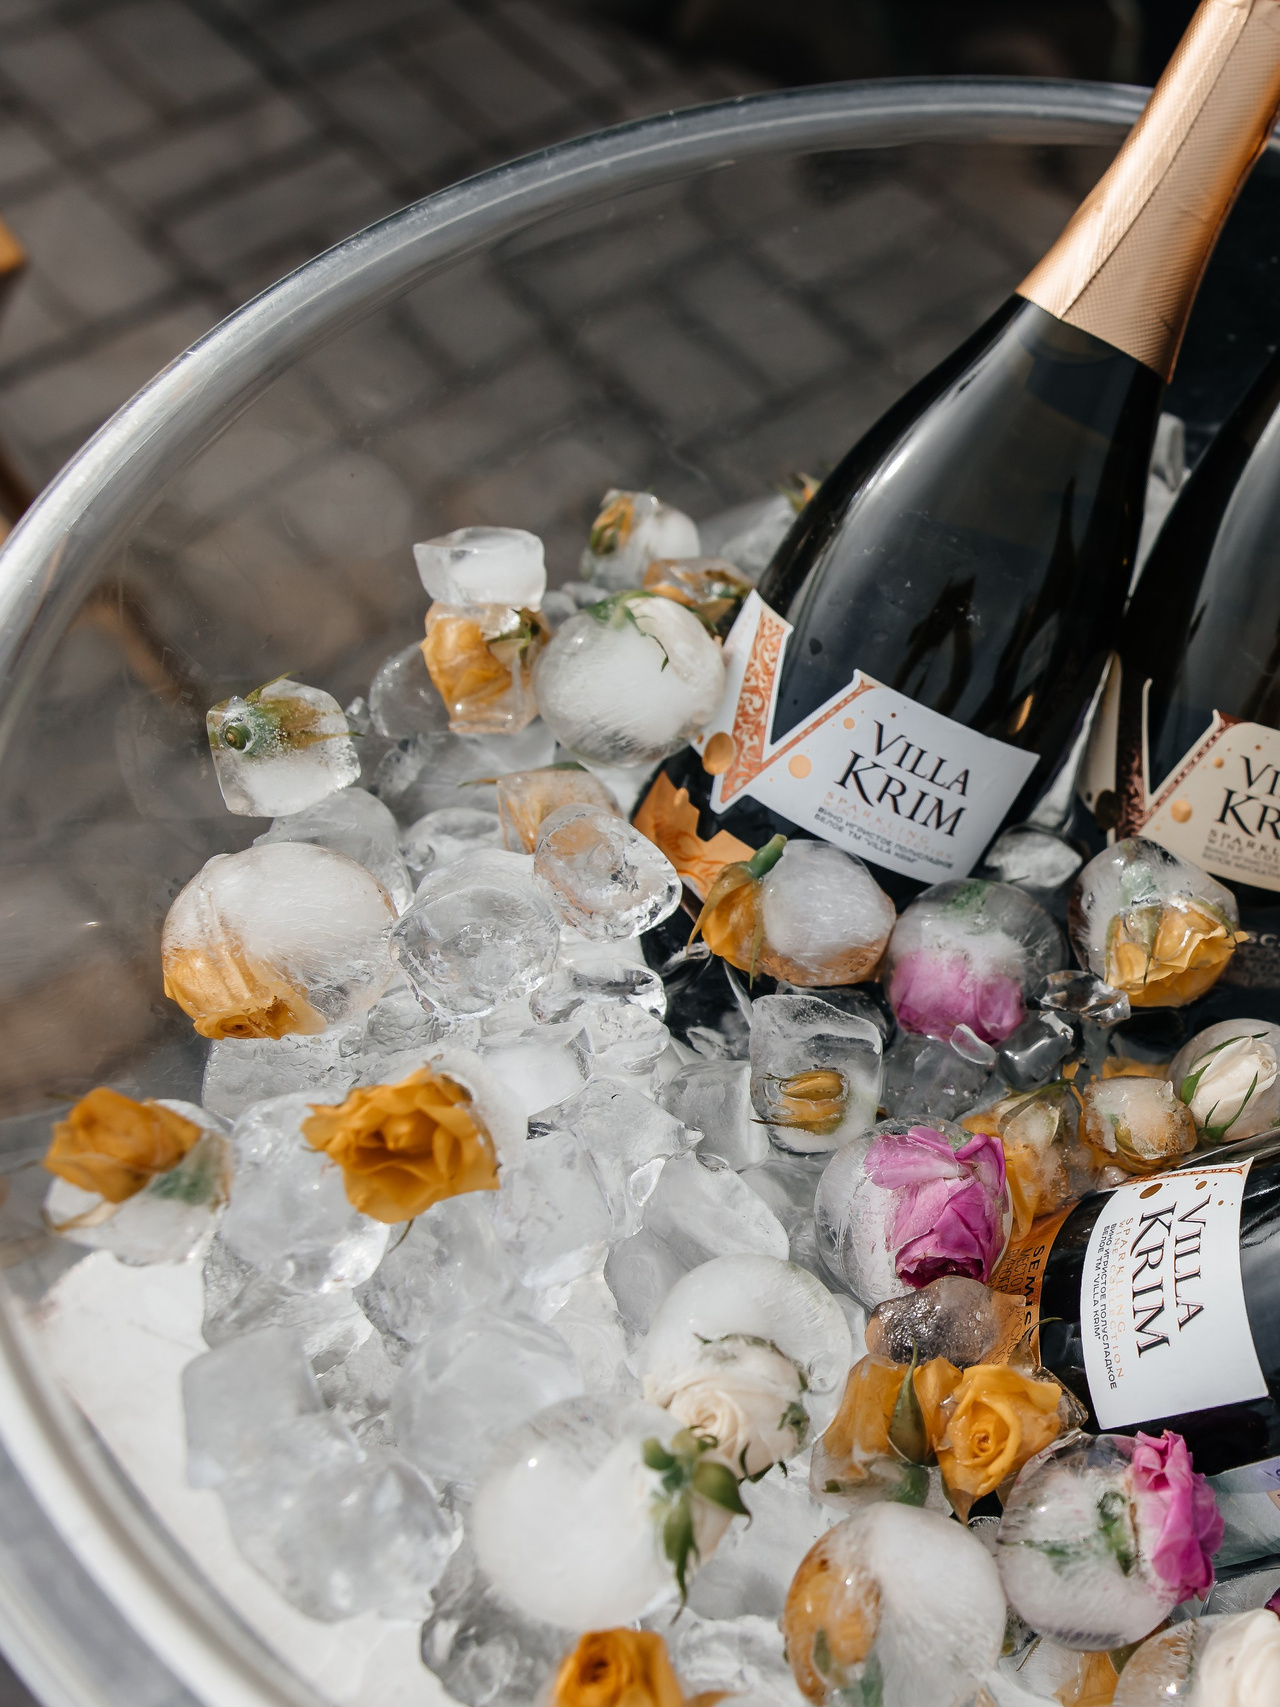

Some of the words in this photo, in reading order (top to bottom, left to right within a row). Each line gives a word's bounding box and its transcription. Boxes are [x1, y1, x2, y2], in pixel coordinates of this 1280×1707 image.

[833, 749, 967, 837] KRIM
[873, 719, 970, 797] VILLA
[1095, 1256, 1103, 1271] ТМ
[1098, 1225, 1110, 1253] БЕЛОЕ
[1100, 1248, 1110, 1300] ИГРИСТОЕ
[1106, 1223, 1117, 1246] ВИНО
[1112, 1219, 1125, 1255] WINE
[1116, 1217, 1134, 1333] SPARKLING
[1173, 1193, 1212, 1332] VILLA
[1108, 1264, 1124, 1377] COLLECTION
[1130, 1201, 1178, 1359] KRIM
[1100, 1304, 1117, 1389] ПОЛУСЛАДКОЕ
